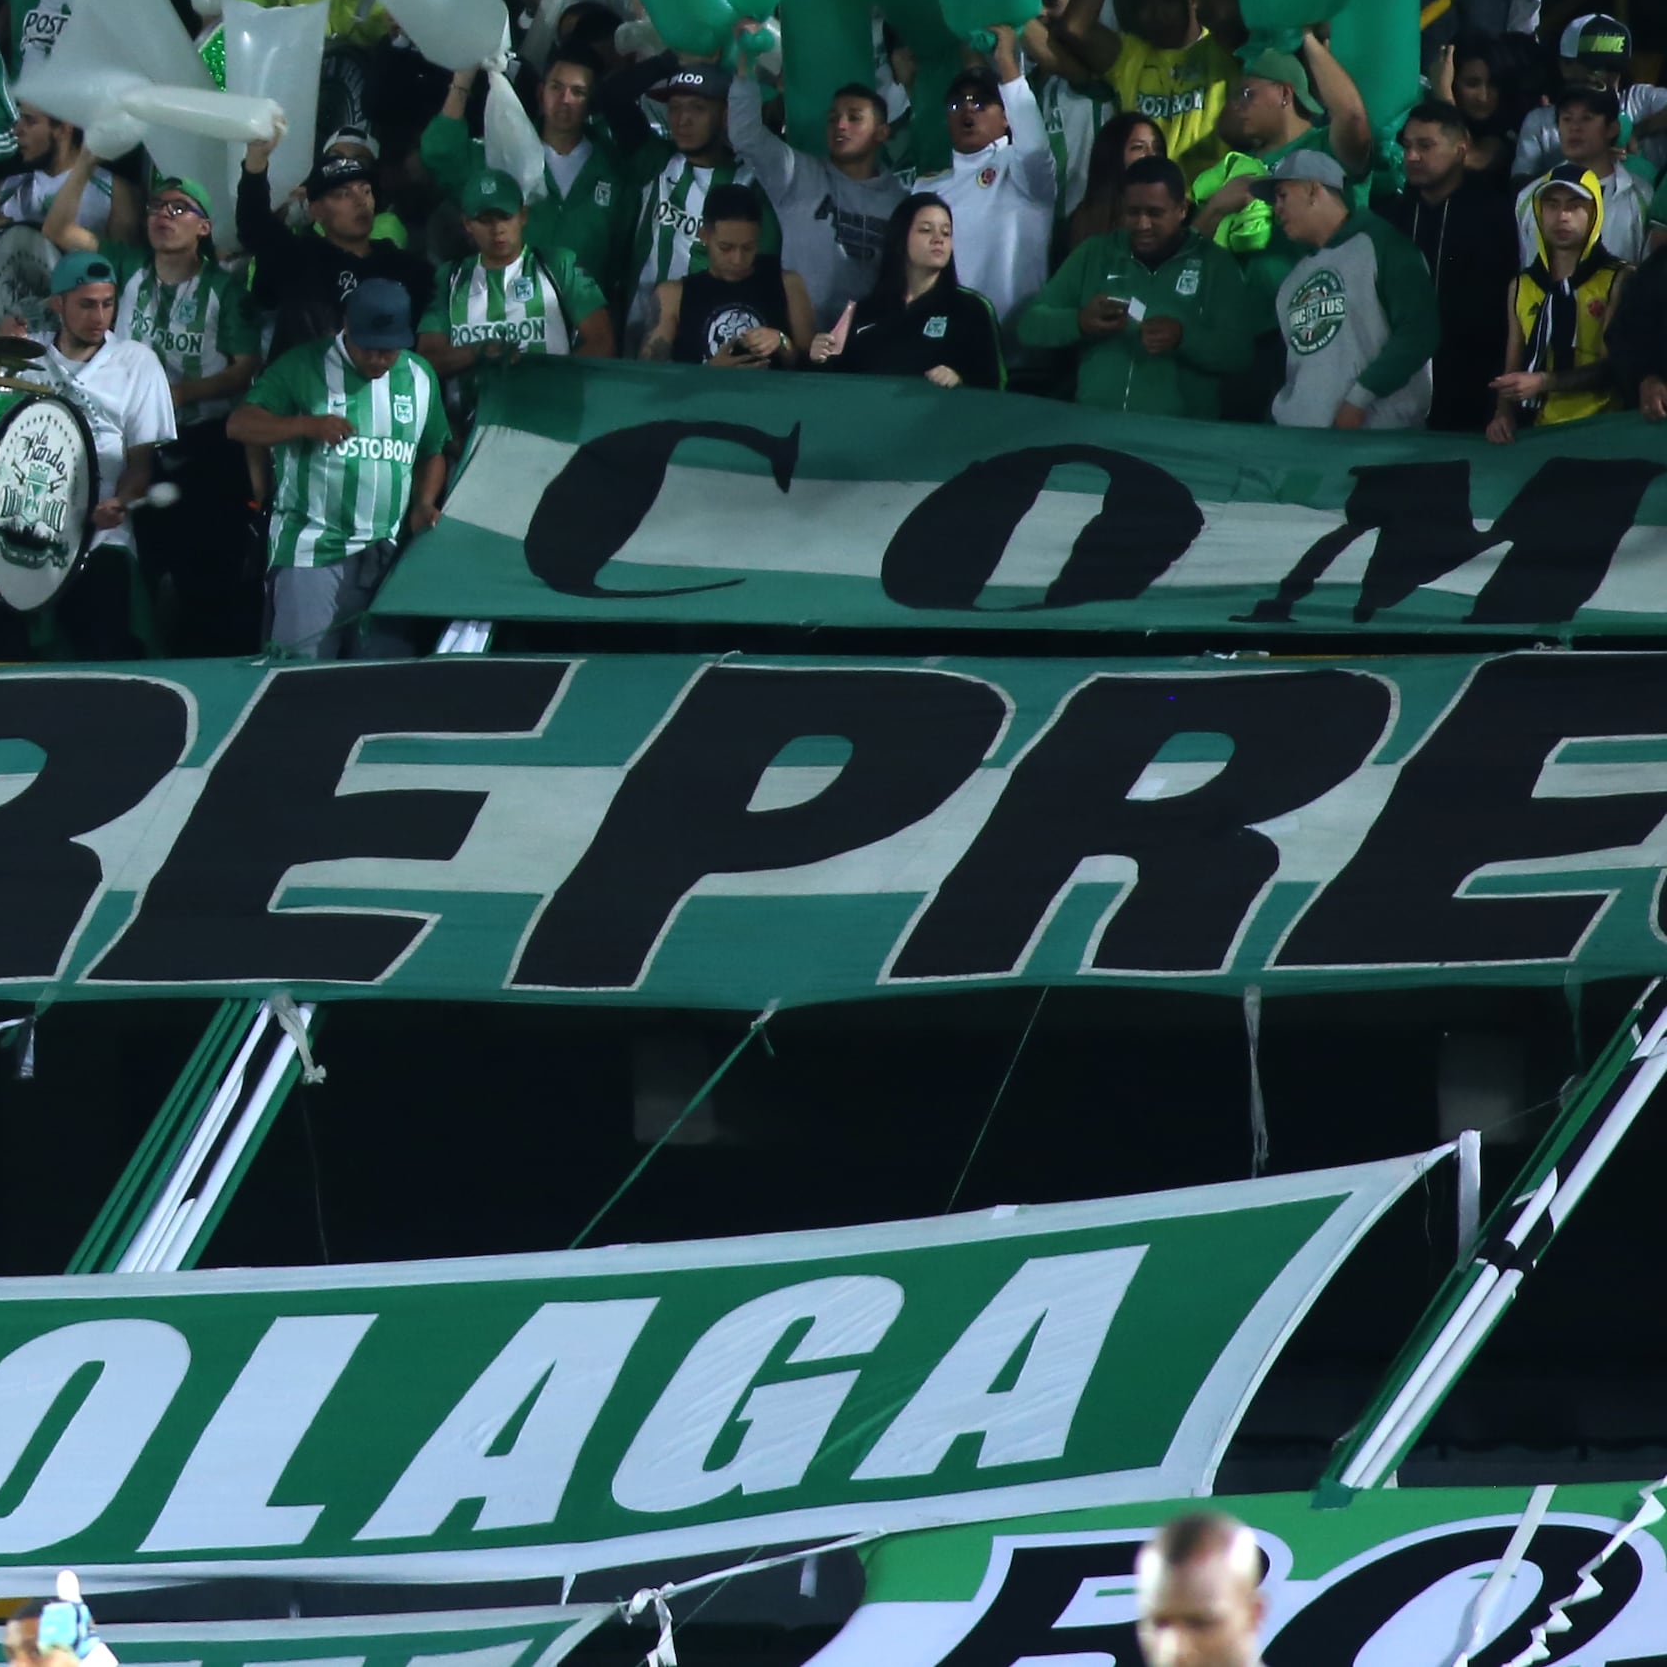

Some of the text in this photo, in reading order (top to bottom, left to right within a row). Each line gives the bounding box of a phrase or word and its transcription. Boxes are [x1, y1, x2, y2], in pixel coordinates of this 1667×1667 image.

[24, 12, 68, 36] POST
[334, 435, 416, 465] OSTOBON
[501, 650, 1667, 991] PRE
